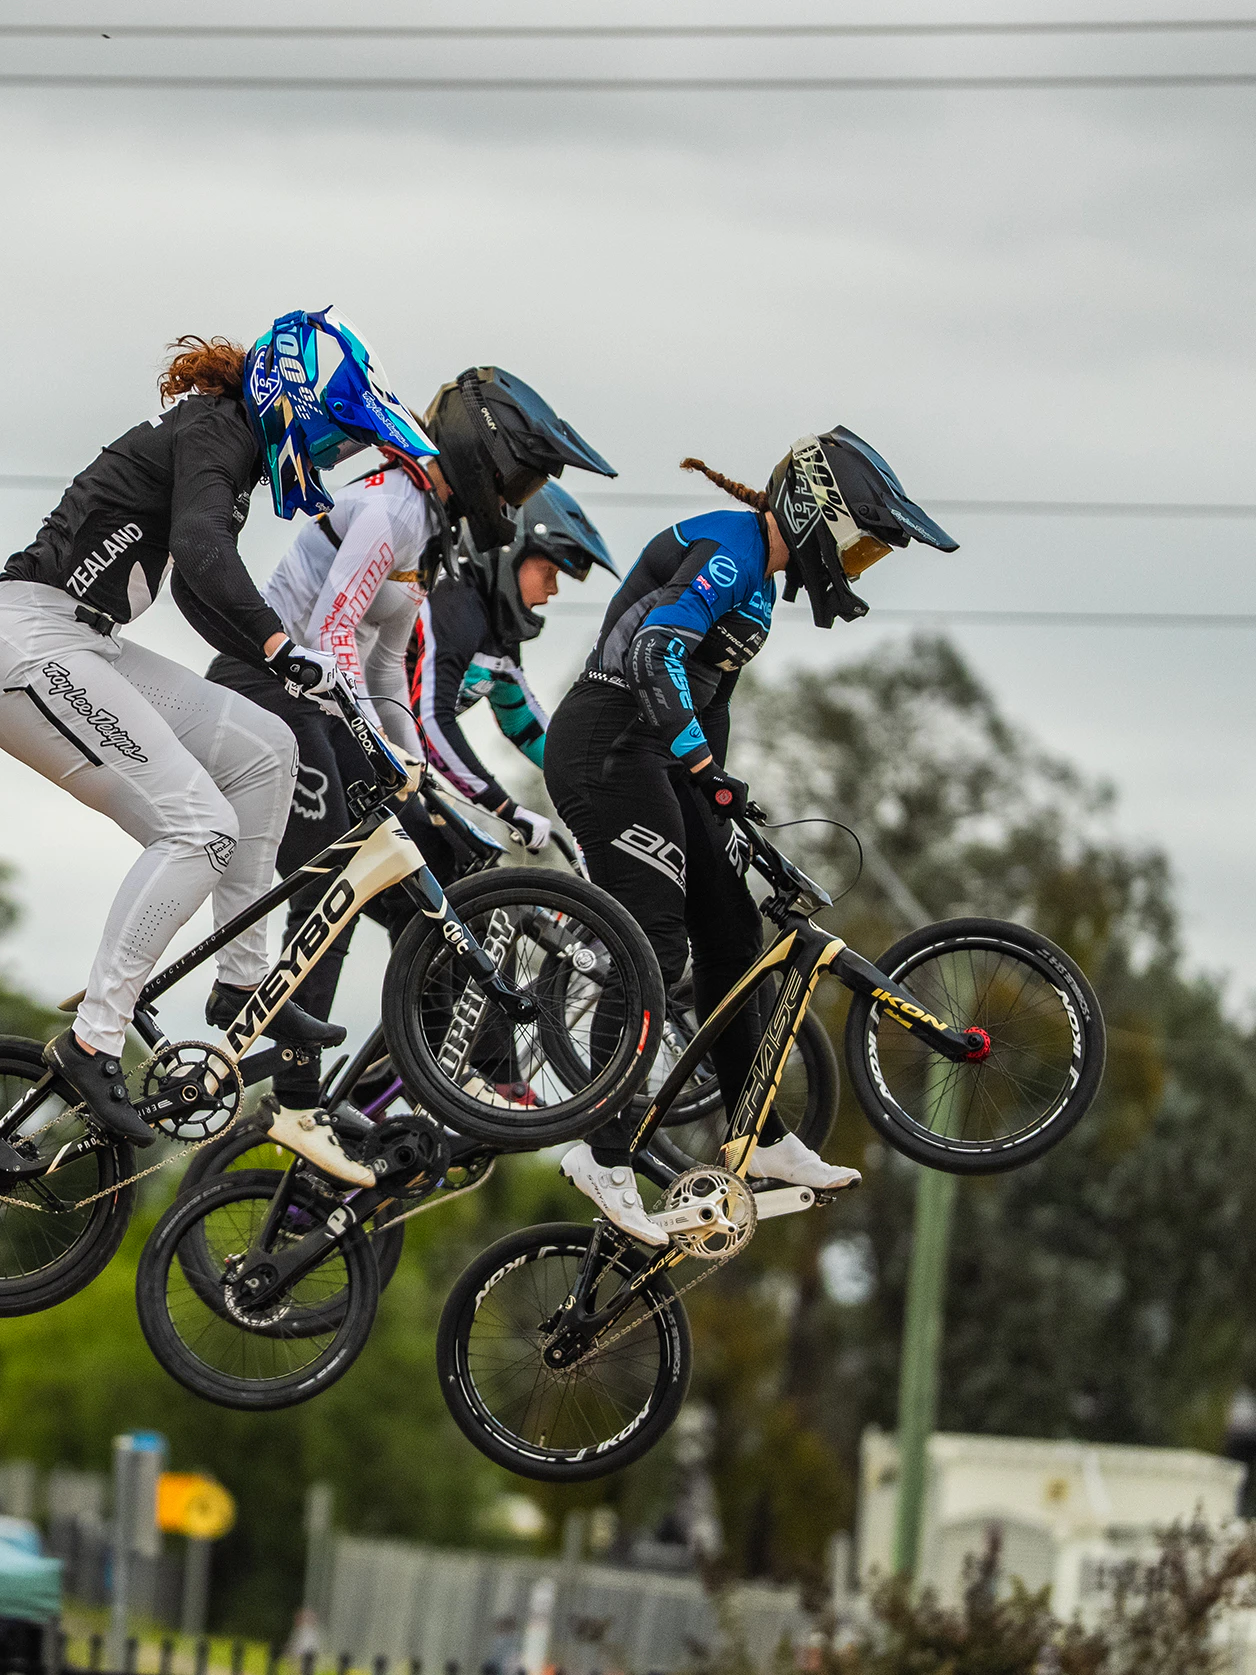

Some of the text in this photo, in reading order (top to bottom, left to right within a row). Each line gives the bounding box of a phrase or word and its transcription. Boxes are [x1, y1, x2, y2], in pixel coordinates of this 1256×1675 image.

[65, 522, 143, 598] ZEALAND
[320, 591, 348, 633] BMX
[644, 646, 655, 678] TIOGA
[42, 661, 149, 763] Troy Lee Designs
[357, 730, 378, 756] box
[144, 959, 186, 993] BICYCLE
[190, 935, 217, 957] MOTO
[225, 878, 356, 1055] MEYBO
[870, 987, 949, 1032] IKON
[1050, 982, 1082, 1059] IKON
[731, 965, 803, 1140] CHASE
[867, 1030, 896, 1102] IKON
[474, 1254, 528, 1314] IKON
[630, 1246, 679, 1291] CHAS
[595, 1392, 654, 1454] IKON
